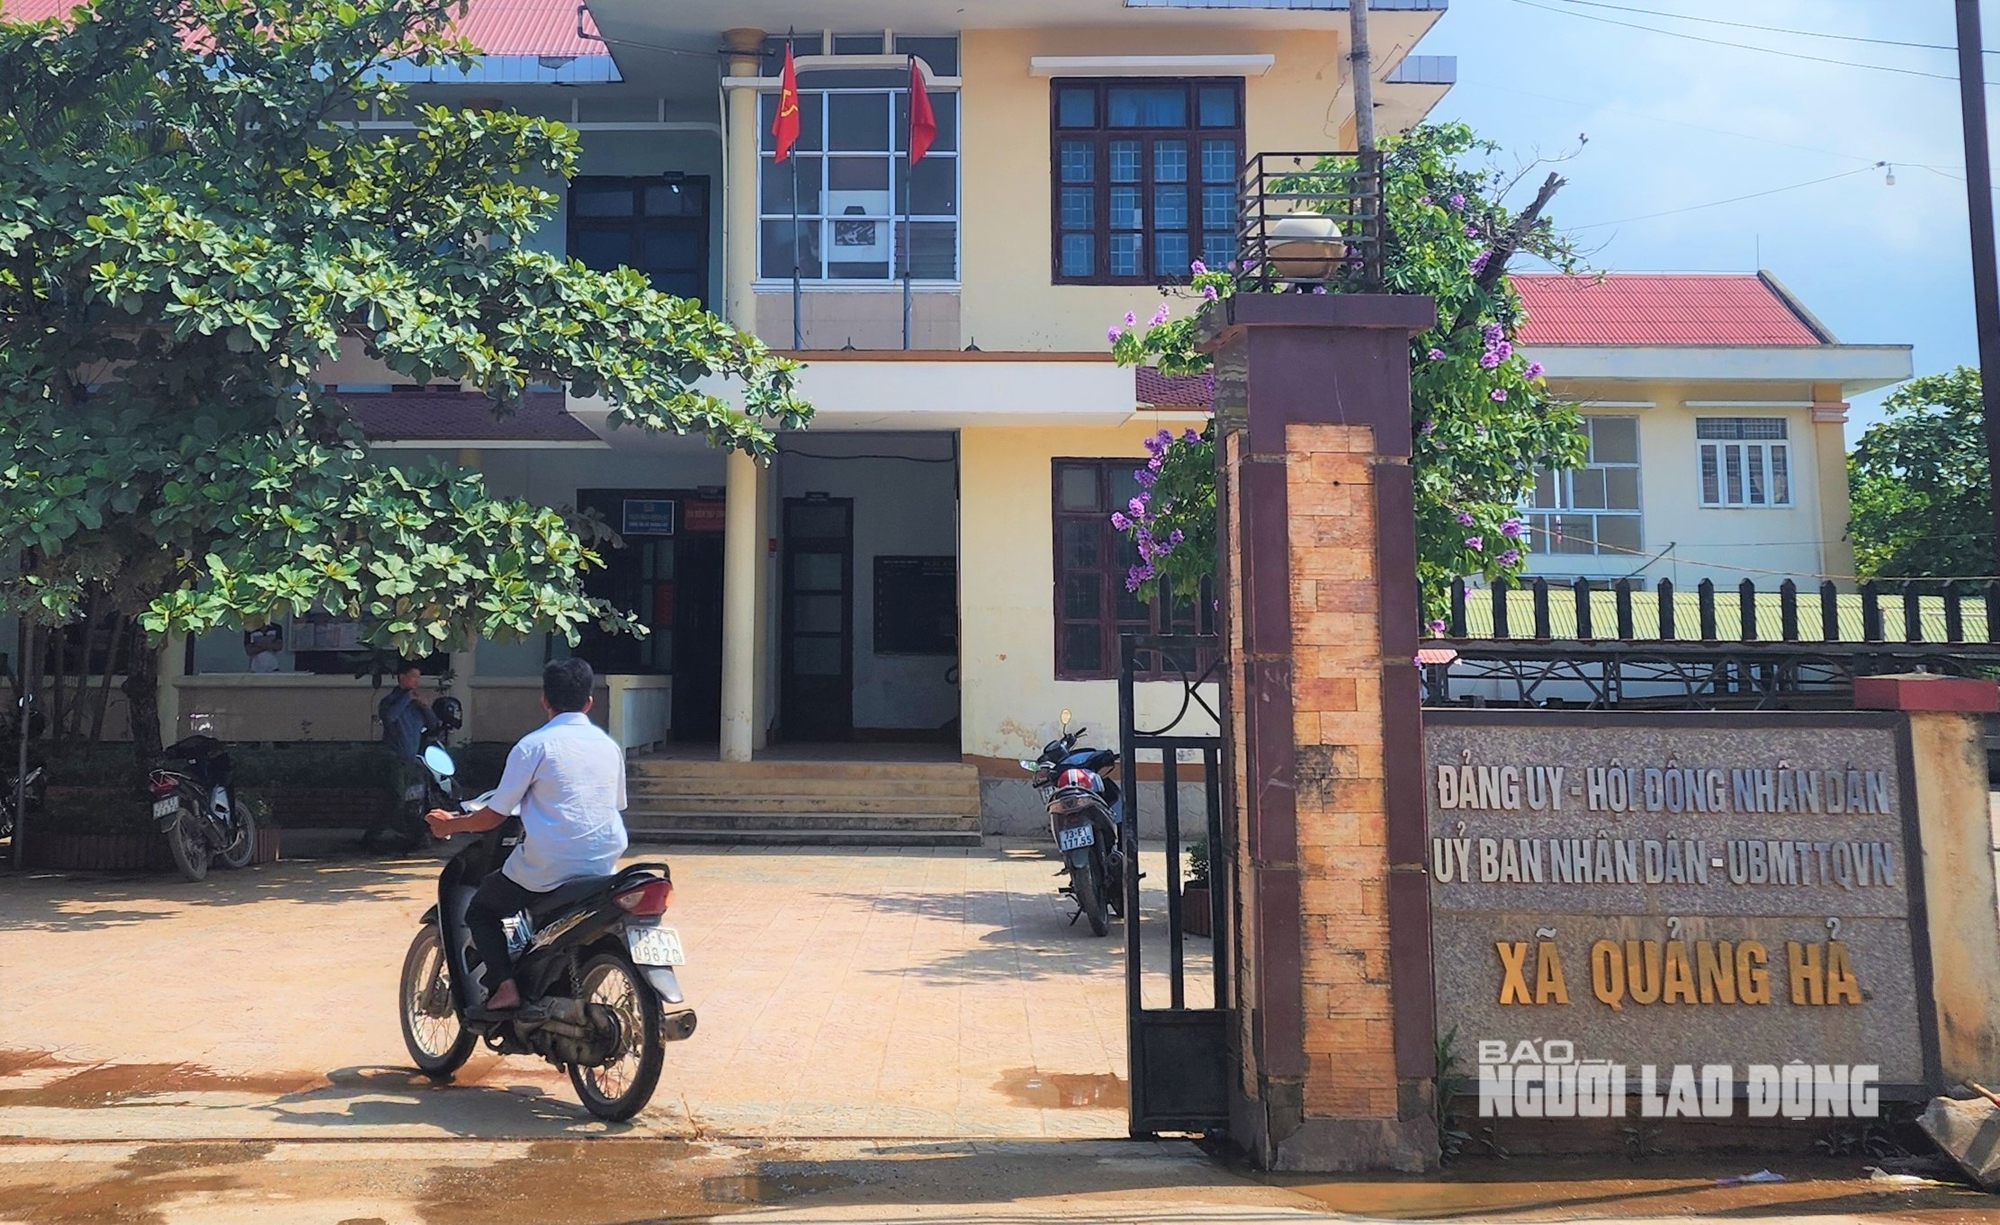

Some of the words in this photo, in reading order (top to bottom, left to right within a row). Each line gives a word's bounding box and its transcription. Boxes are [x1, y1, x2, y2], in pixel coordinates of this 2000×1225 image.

[1437, 749, 1521, 810] ĐẢNG
[1586, 758, 1636, 821] HỘI
[1732, 758, 1820, 815] NHÂN
[1063, 836, 1093, 849] 177.55
[1064, 827, 1087, 840] 73-E1
[1432, 820, 1471, 884] UỶ
[1479, 838, 1544, 884] BAN
[1550, 829, 1638, 885] NHÂN
[1727, 839, 1896, 892] UBMTTQVN
[1494, 926, 1570, 1006] XÃ
[1590, 916, 1772, 1012] QUẢNG
